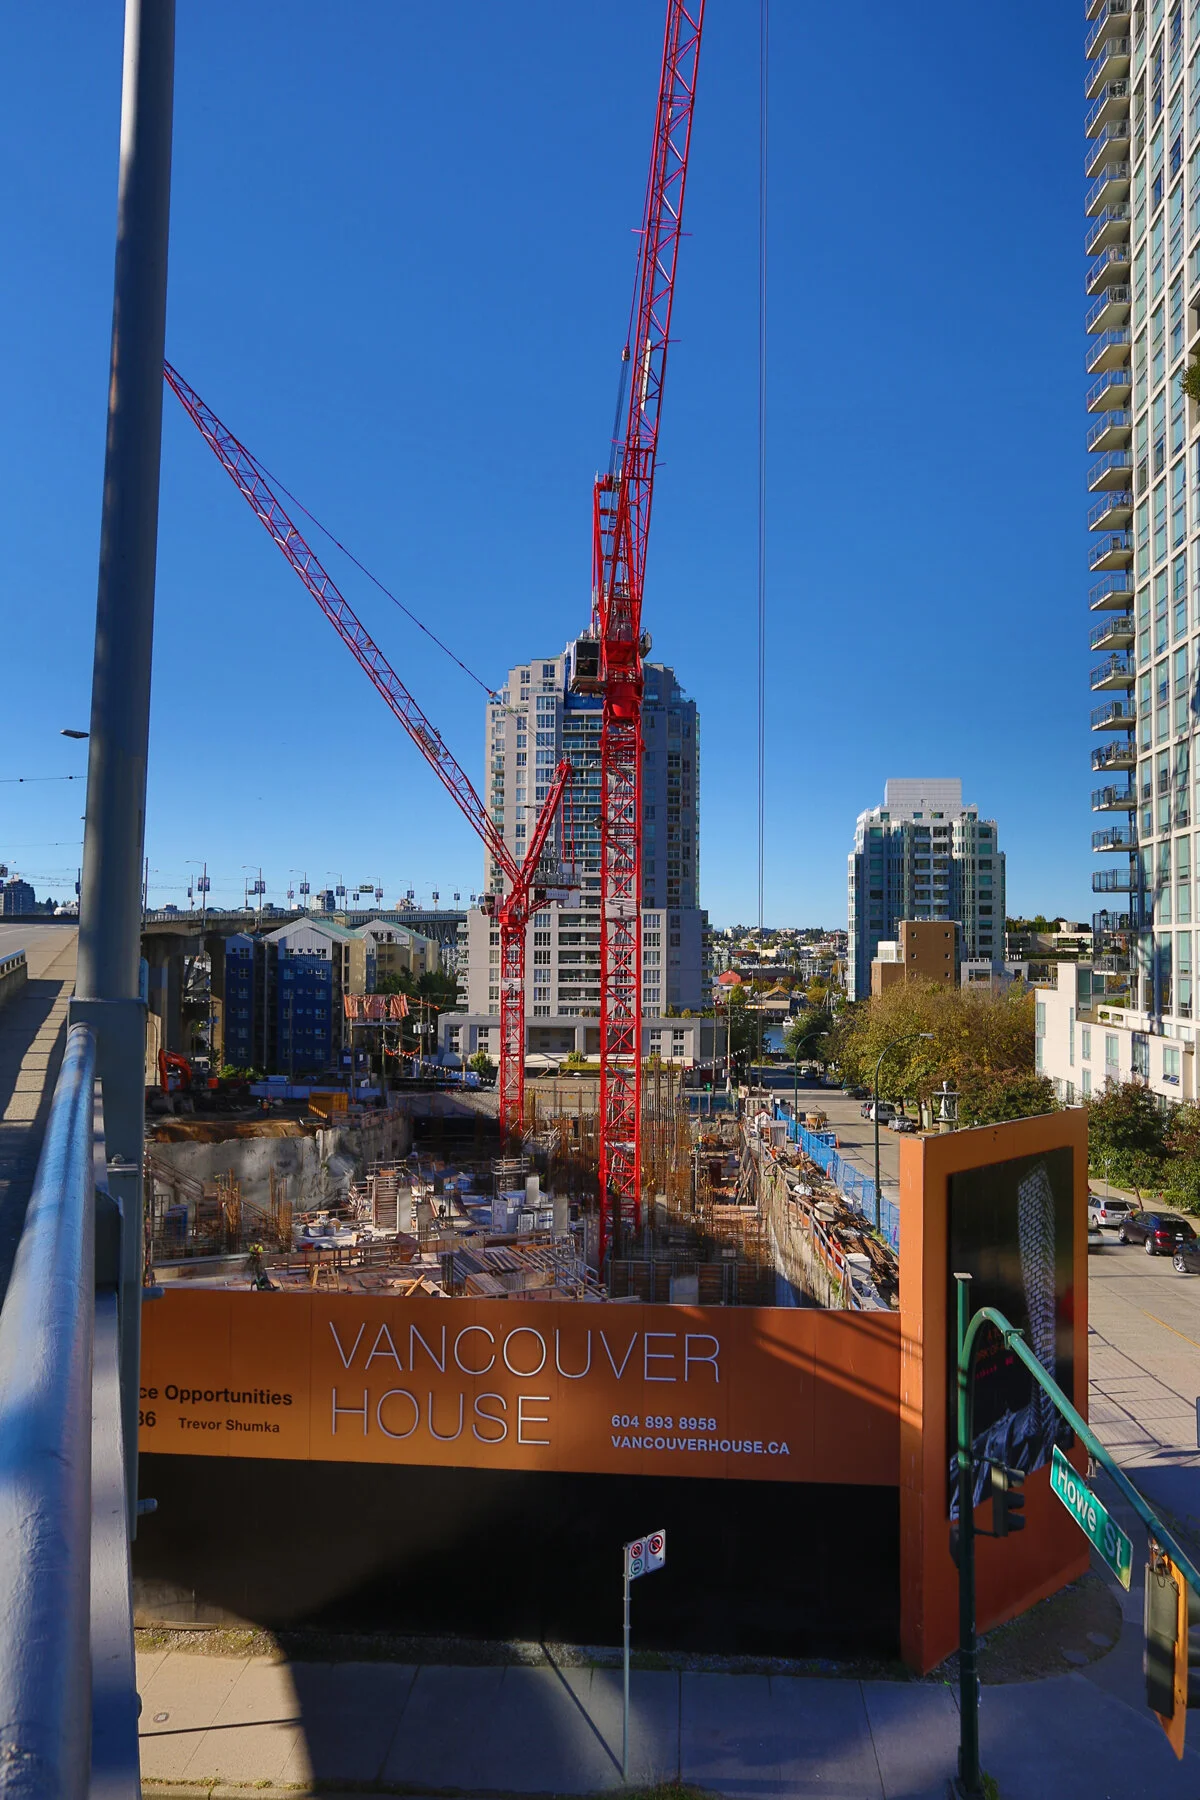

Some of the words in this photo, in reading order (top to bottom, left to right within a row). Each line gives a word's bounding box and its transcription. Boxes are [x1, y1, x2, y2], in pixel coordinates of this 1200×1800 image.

[329, 1321, 720, 1384] VANCOUVER
[164, 1384, 293, 1406] Opportunities
[178, 1417, 222, 1431] Trevor
[225, 1418, 280, 1433] Shumka
[331, 1387, 550, 1445] HOUSE
[611, 1414, 640, 1428] 604
[645, 1415, 673, 1429] 893
[678, 1416, 717, 1431] 8958
[611, 1435, 791, 1455] VANCOUVERHOUSE.CA
[1057, 1459, 1098, 1532] Howe
[1103, 1521, 1123, 1569] St
